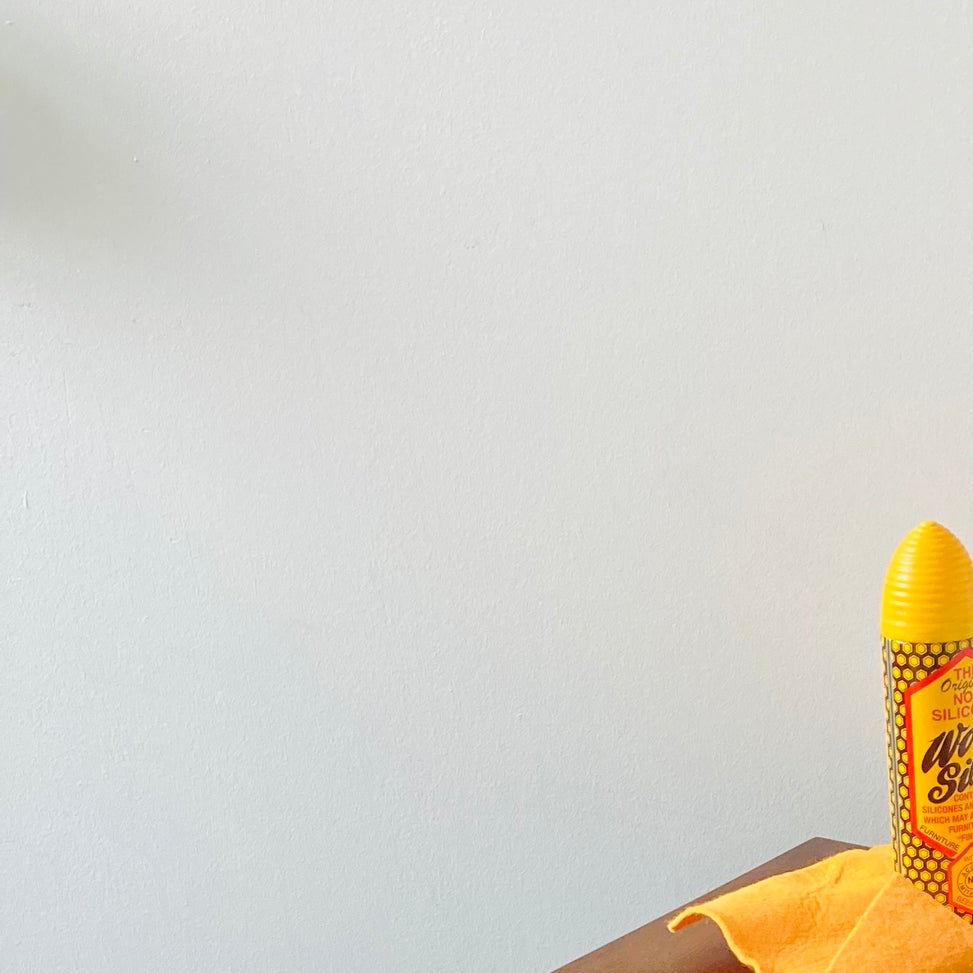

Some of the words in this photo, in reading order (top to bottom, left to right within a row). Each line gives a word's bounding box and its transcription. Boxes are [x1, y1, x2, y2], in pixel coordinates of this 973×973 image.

[922, 804, 963, 814] SILICONES
[924, 816, 950, 824] WHICH
[952, 813, 968, 822] MAY
[920, 824, 960, 851] FURNITURE
